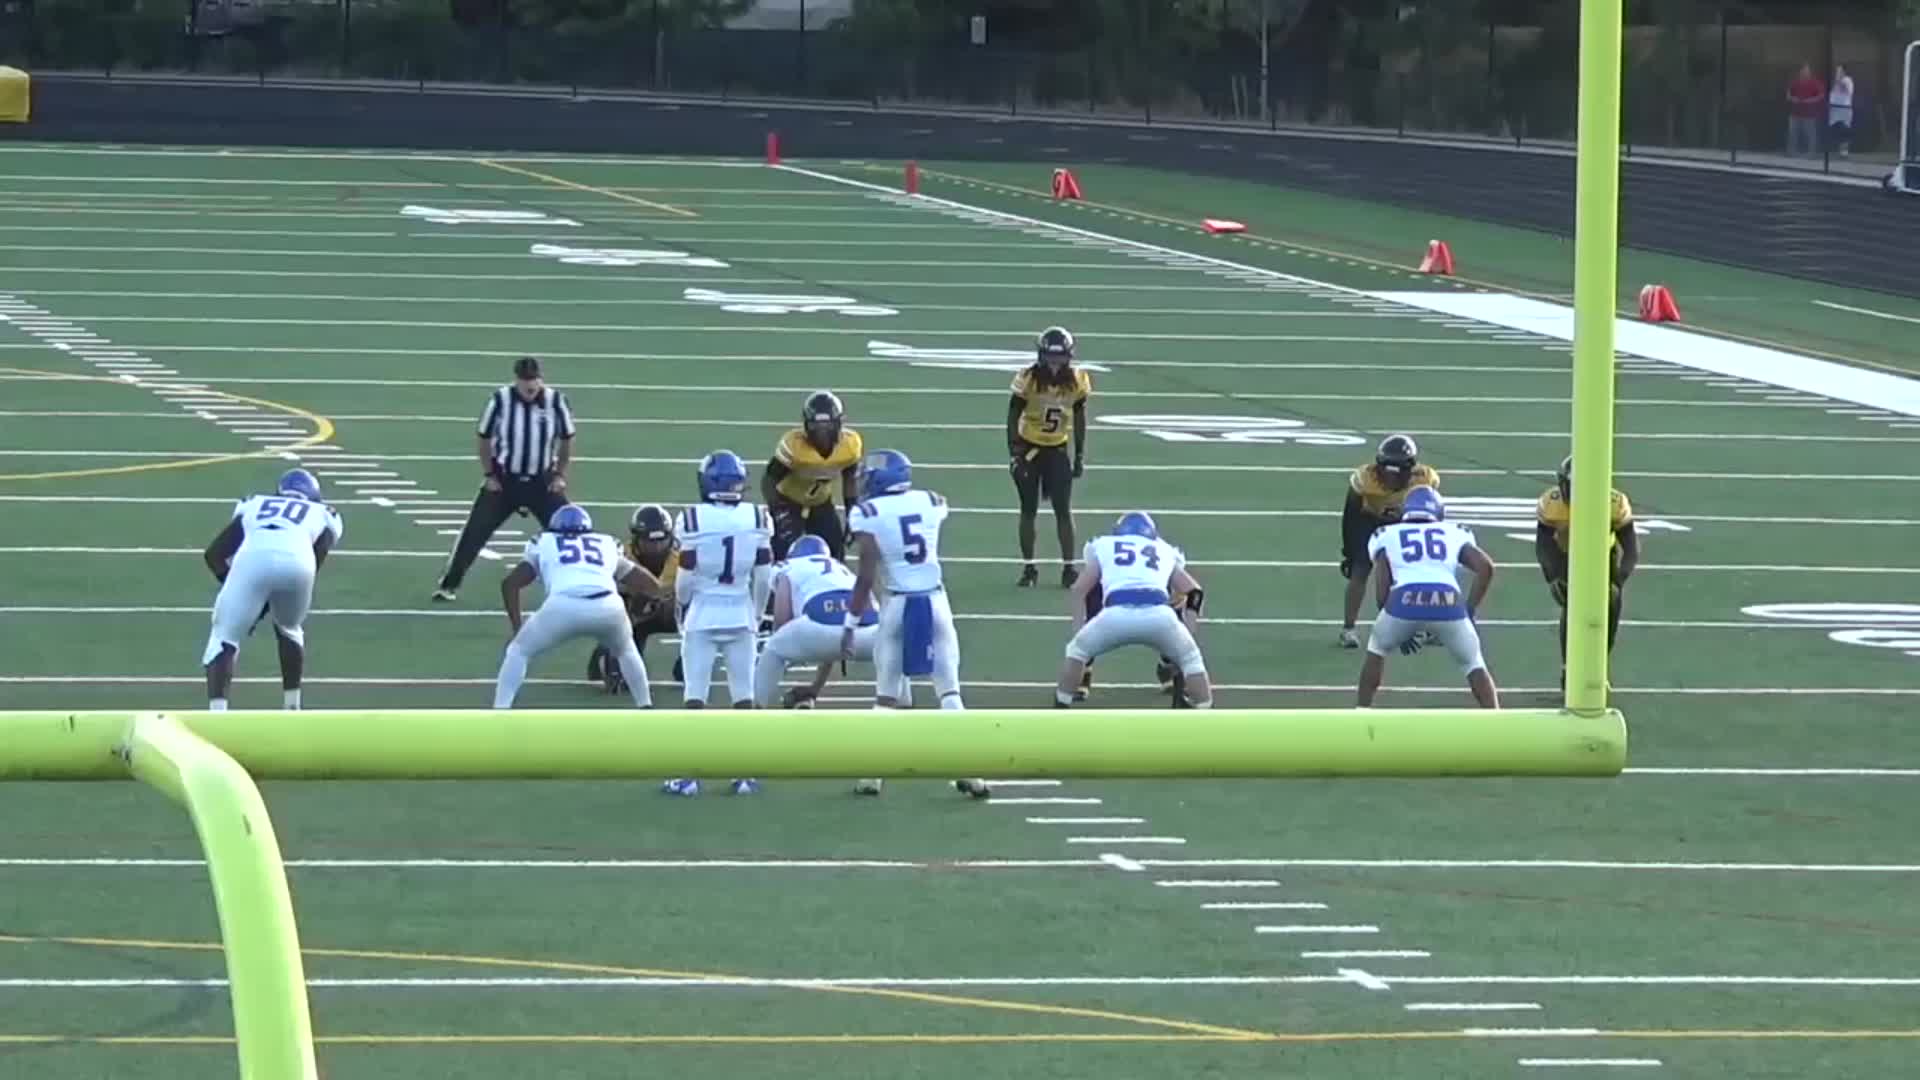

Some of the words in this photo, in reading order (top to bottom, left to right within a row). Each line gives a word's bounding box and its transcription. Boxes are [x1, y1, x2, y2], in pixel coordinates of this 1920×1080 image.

[1041, 407, 1063, 433] 5
[1095, 414, 1367, 445] 50
[256, 499, 310, 525] 50
[556, 536, 604, 566] 55
[899, 513, 927, 565] 5
[1399, 528, 1447, 563] 56
[718, 535, 734, 584] 1
[1113, 540, 1161, 571] 54
